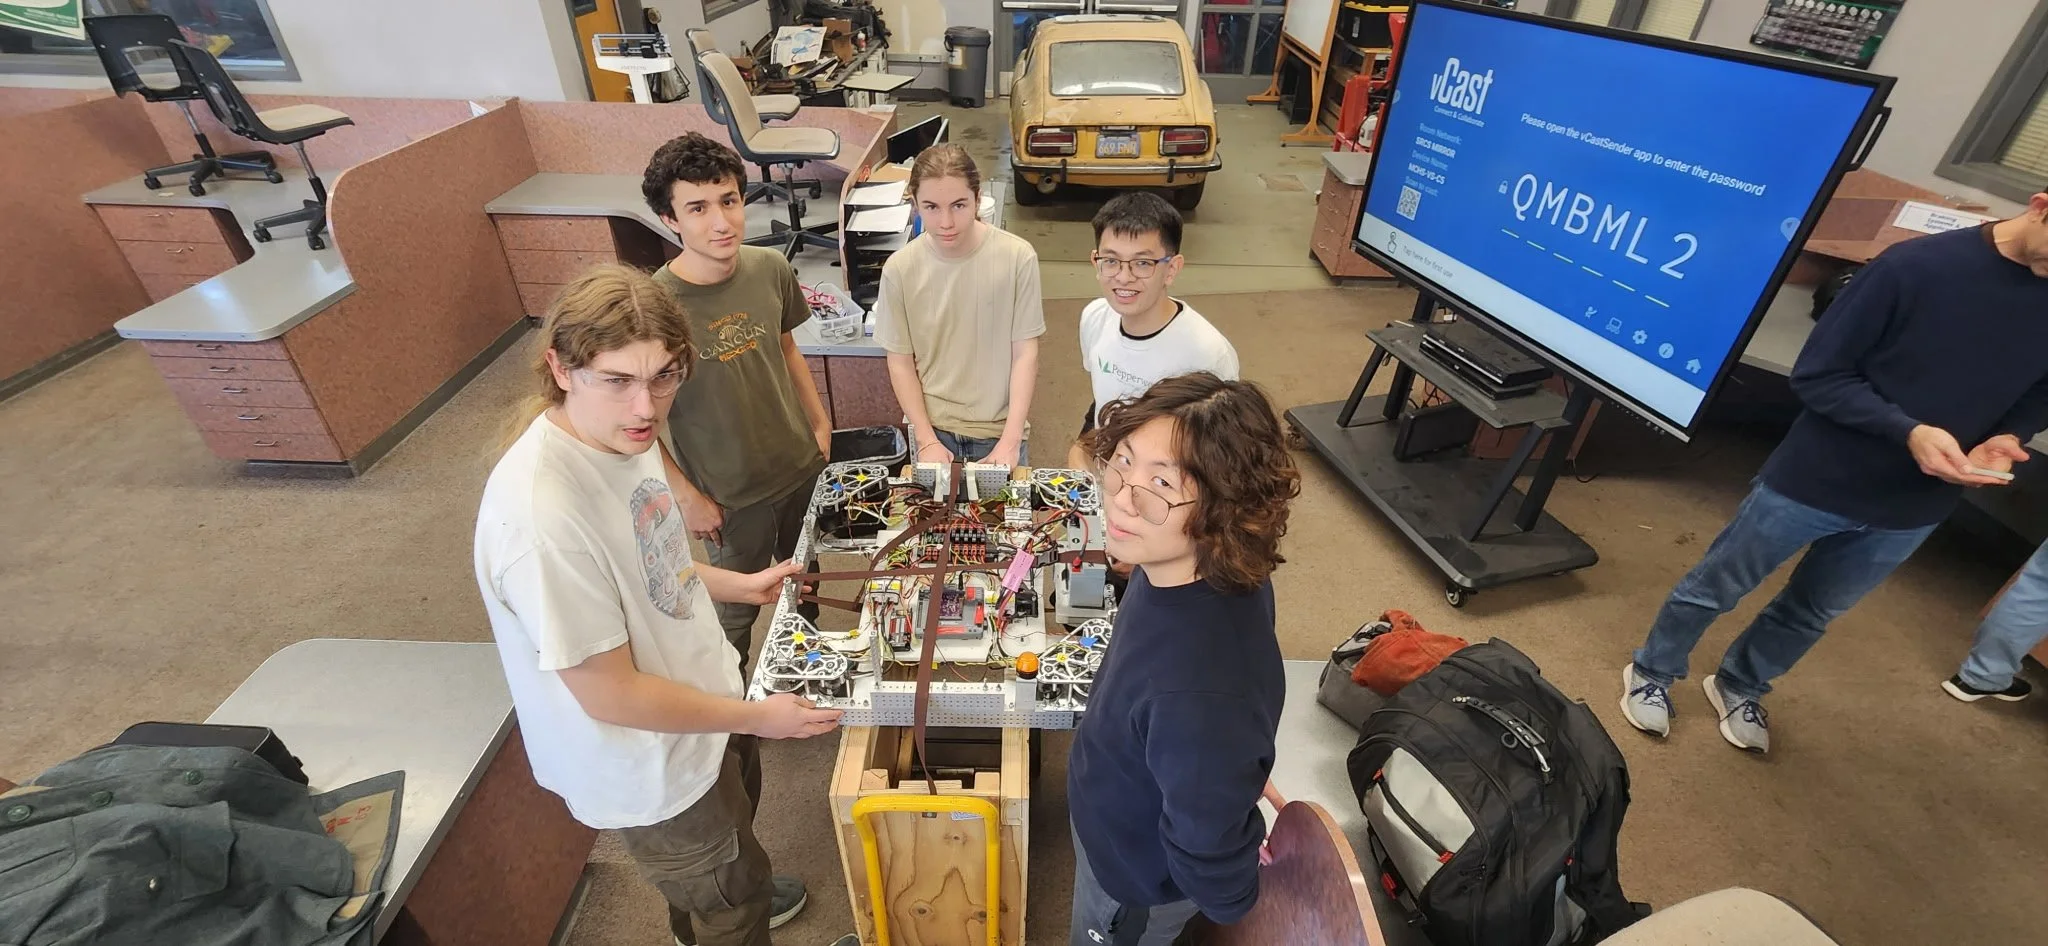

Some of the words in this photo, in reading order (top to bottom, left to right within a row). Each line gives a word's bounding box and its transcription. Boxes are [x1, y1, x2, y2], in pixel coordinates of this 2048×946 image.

[1430, 57, 1493, 115] vCast
[1521, 113, 1546, 128] Please
[1546, 122, 1566, 134] open
[1566, 127, 1580, 139] the
[1580, 132, 1634, 156] vCastSender
[1634, 149, 1653, 163] app
[1653, 153, 1664, 165] to
[1664, 158, 1692, 173] enter
[1692, 165, 1709, 179] the
[1708, 172, 1767, 196] password
[699, 323, 767, 361] CANCUN
